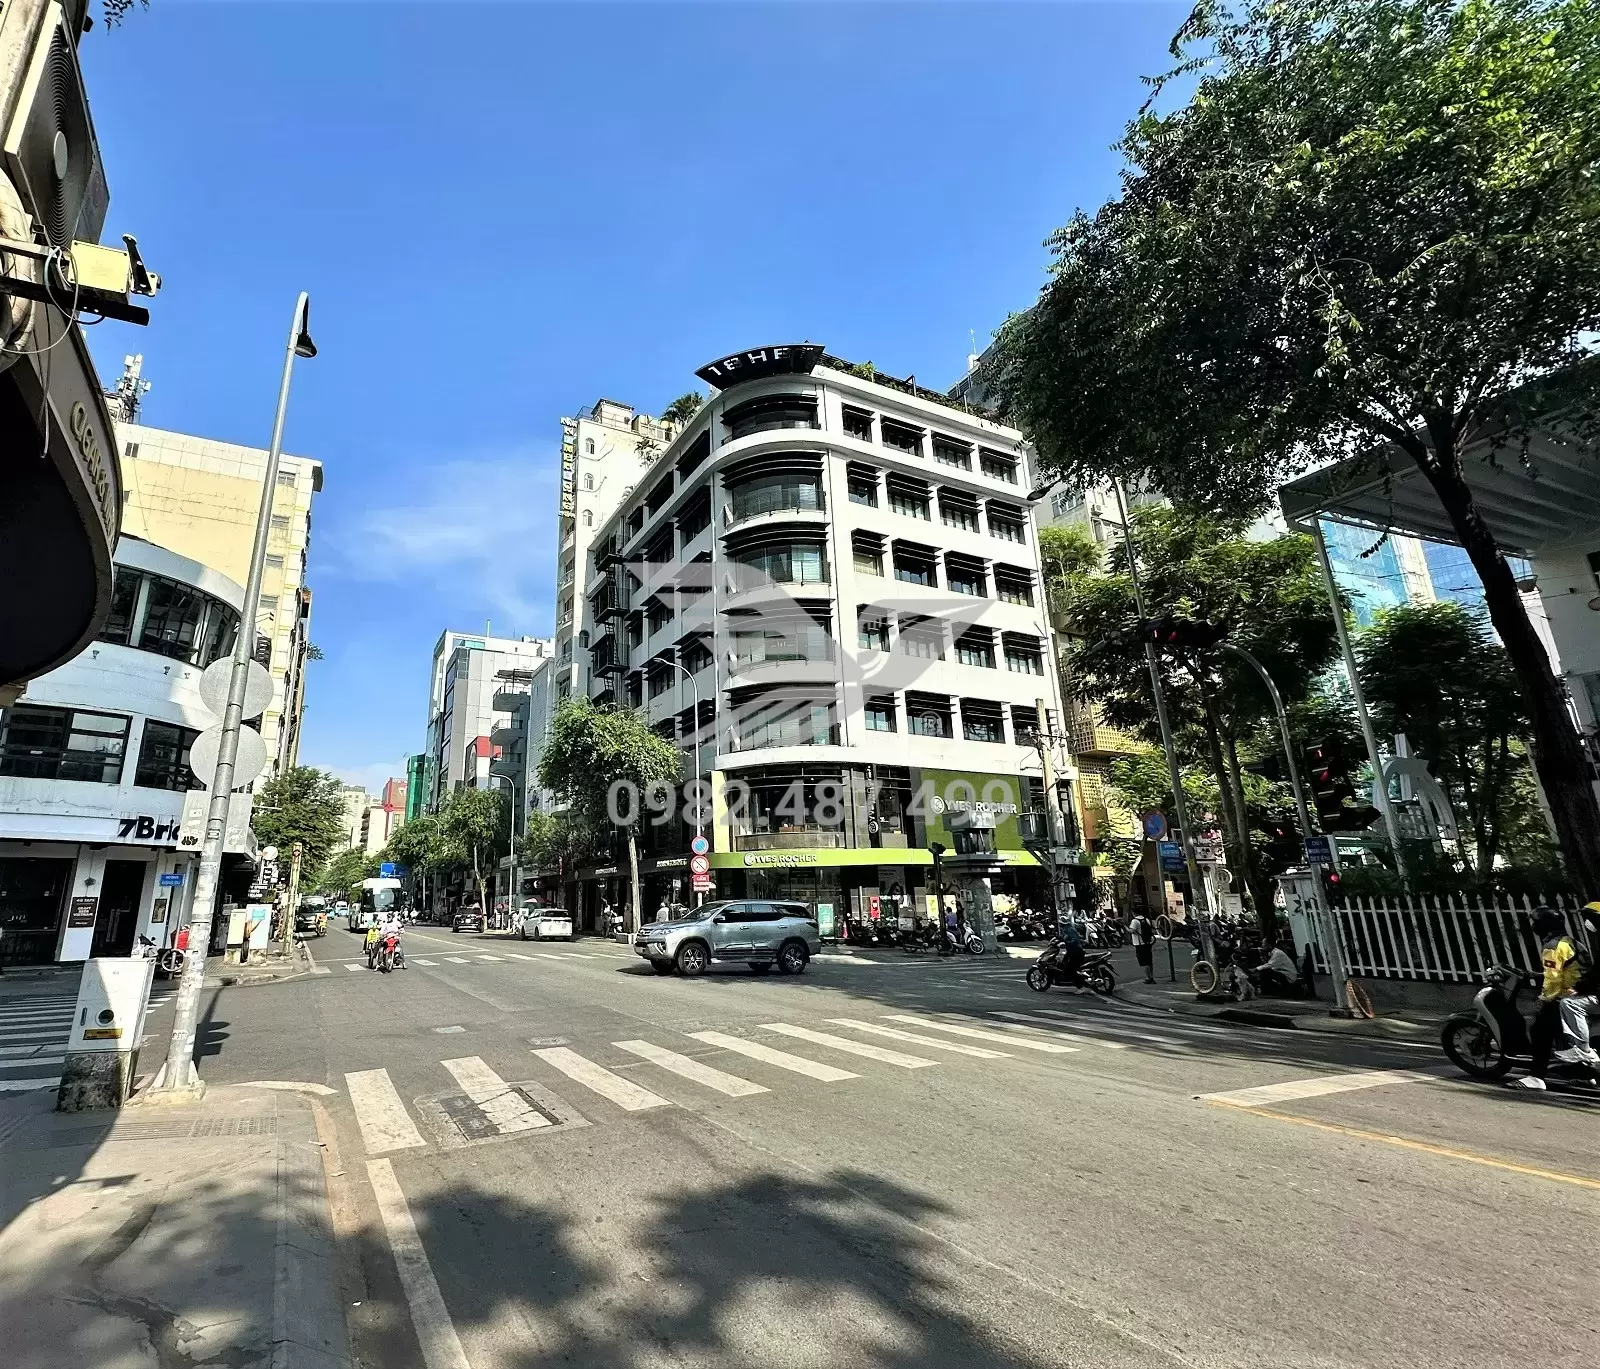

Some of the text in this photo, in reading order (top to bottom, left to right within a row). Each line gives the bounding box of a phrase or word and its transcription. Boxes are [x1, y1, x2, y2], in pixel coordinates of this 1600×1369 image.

[1077, 713, 1091, 721] SPA
[944, 800, 1017, 813] YVES ROCHER
[755, 854, 817, 863] YVES ROCHER
